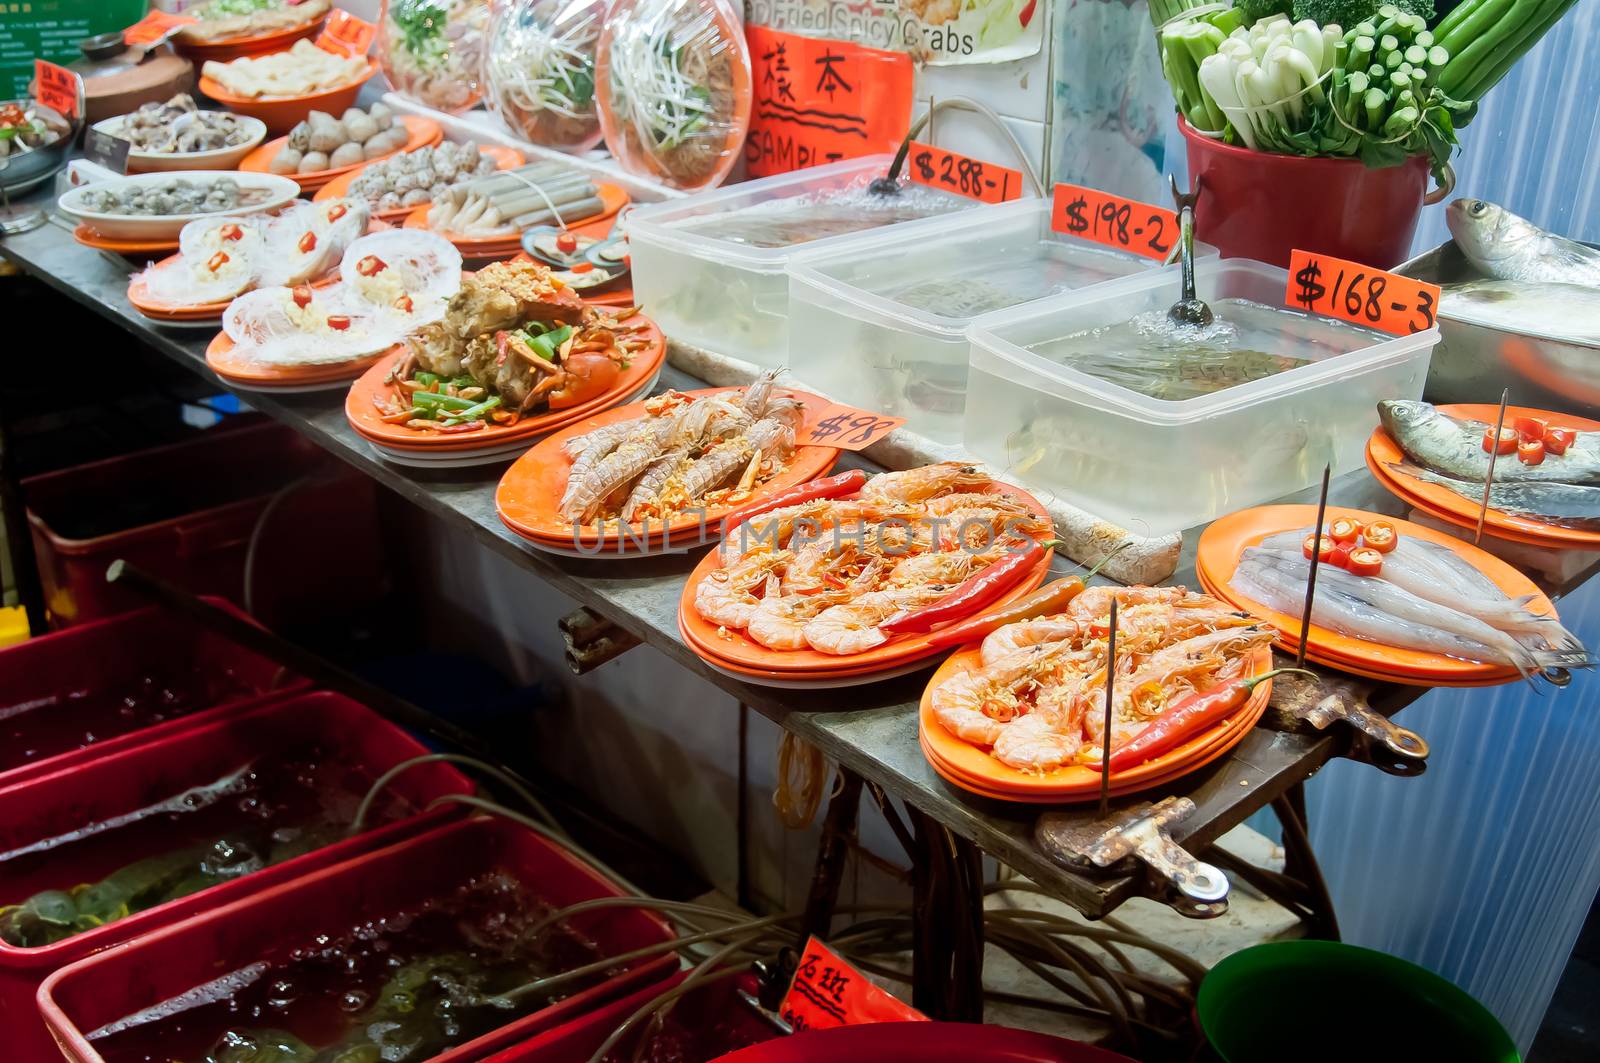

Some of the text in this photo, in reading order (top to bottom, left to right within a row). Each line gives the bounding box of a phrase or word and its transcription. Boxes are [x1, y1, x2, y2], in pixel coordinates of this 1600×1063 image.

[834, 8, 896, 47] Spicy
[1065, 194, 1169, 253] $198-2
[1295, 258, 1434, 334] $168-3
